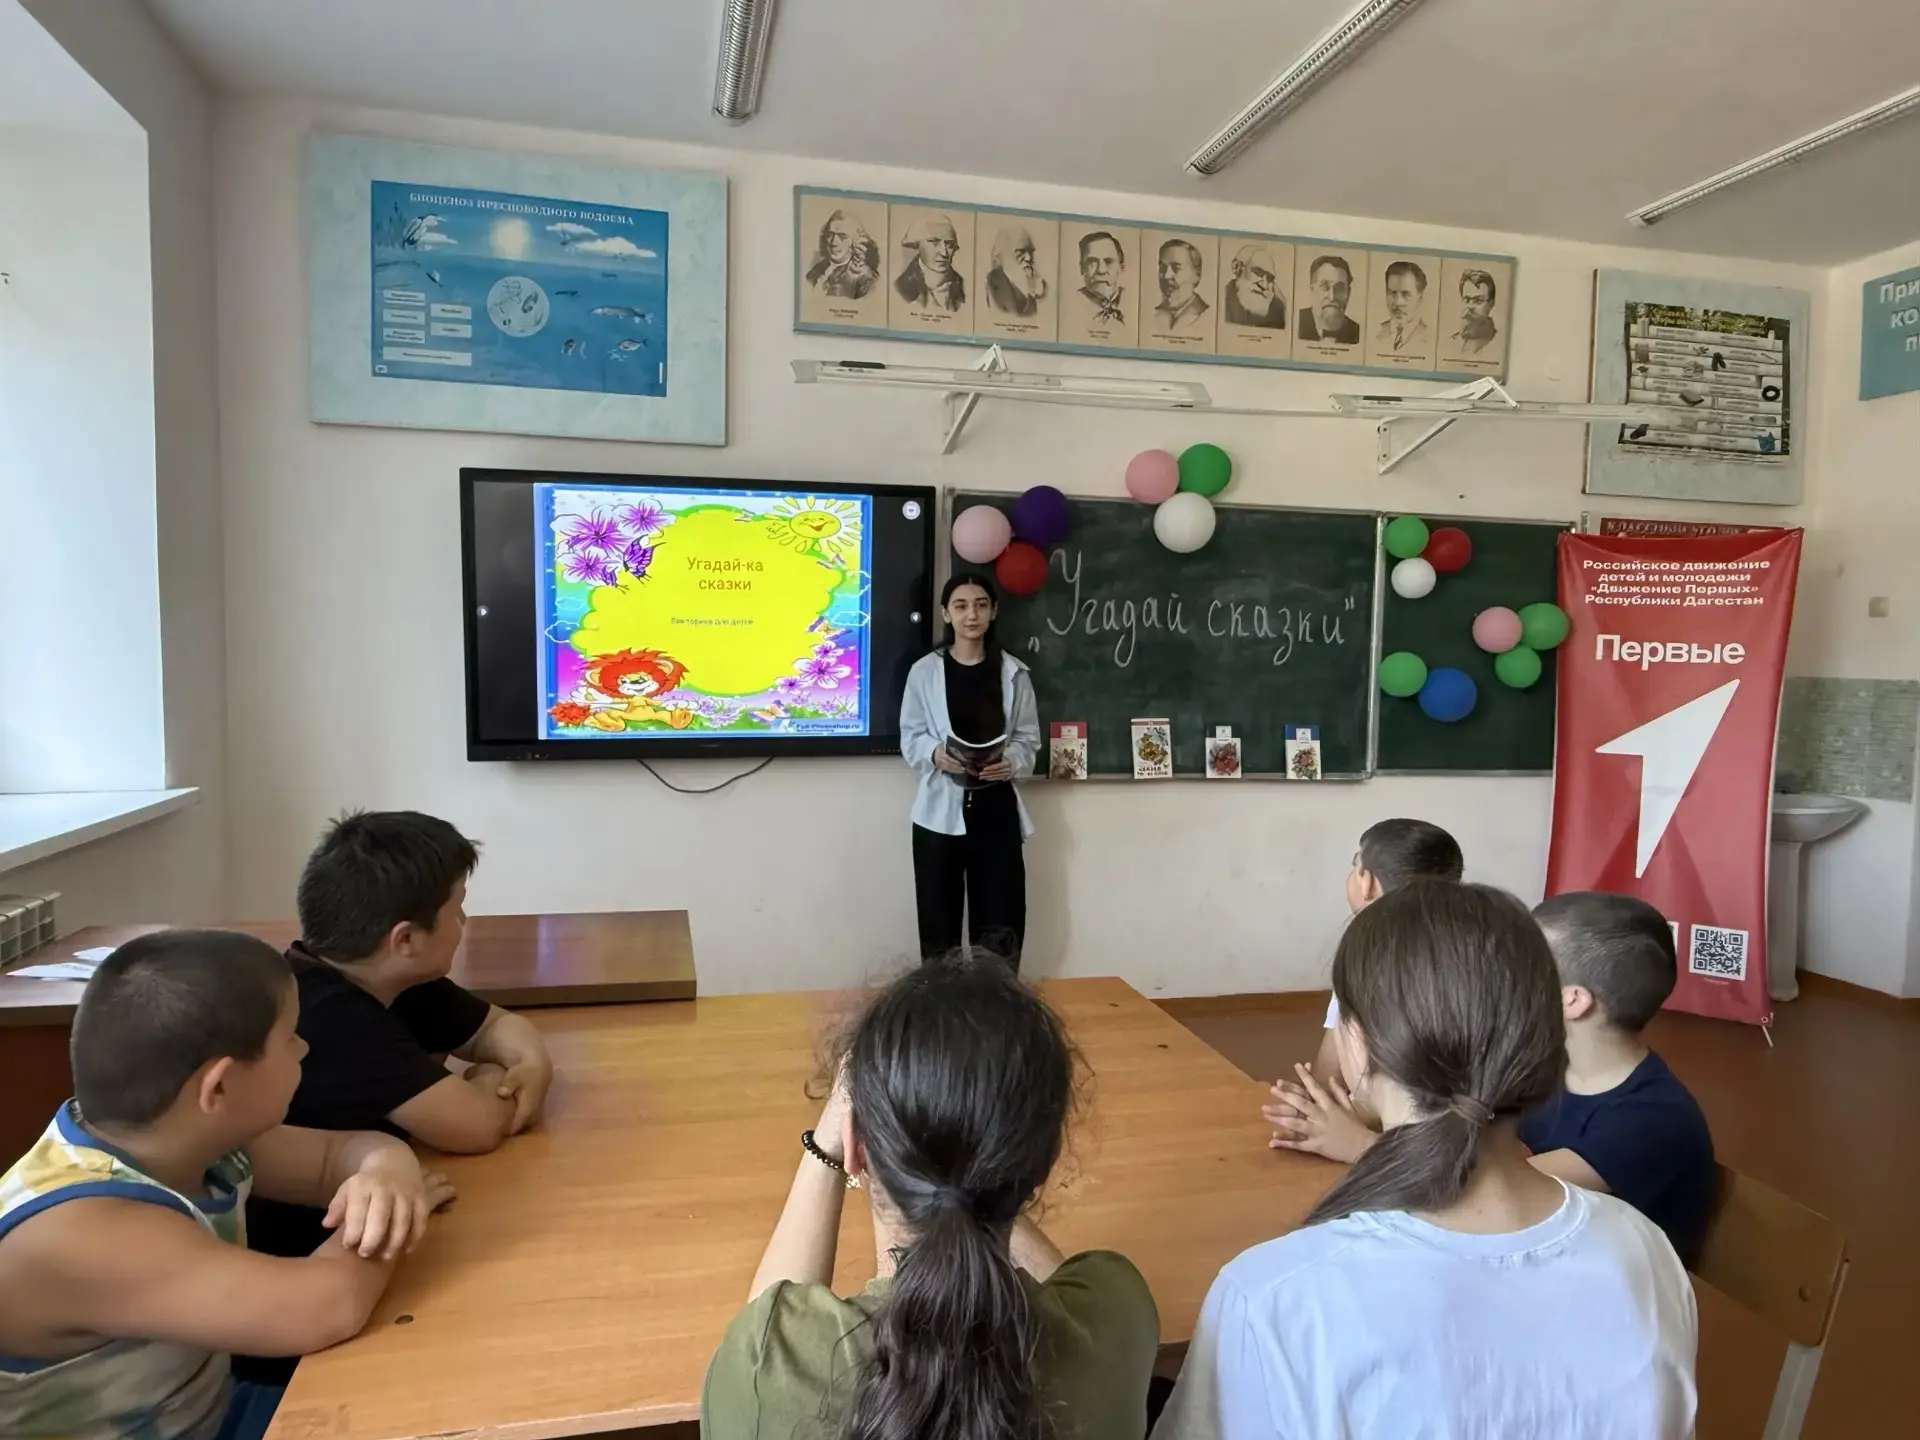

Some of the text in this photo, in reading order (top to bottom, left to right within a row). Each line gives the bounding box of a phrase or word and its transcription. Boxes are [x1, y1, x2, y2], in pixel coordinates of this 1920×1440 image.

[686, 556, 764, 573] Угадай-ка
[1583, 560, 1770, 571] Российское движение
[1598, 573, 1751, 583] детей и молодежи
[698, 579, 752, 591] сказки
[1591, 583, 1759, 595] «Движение Первых»
[1585, 594, 1764, 607] Республики Дагестан
[1595, 634, 1746, 671] Первые
